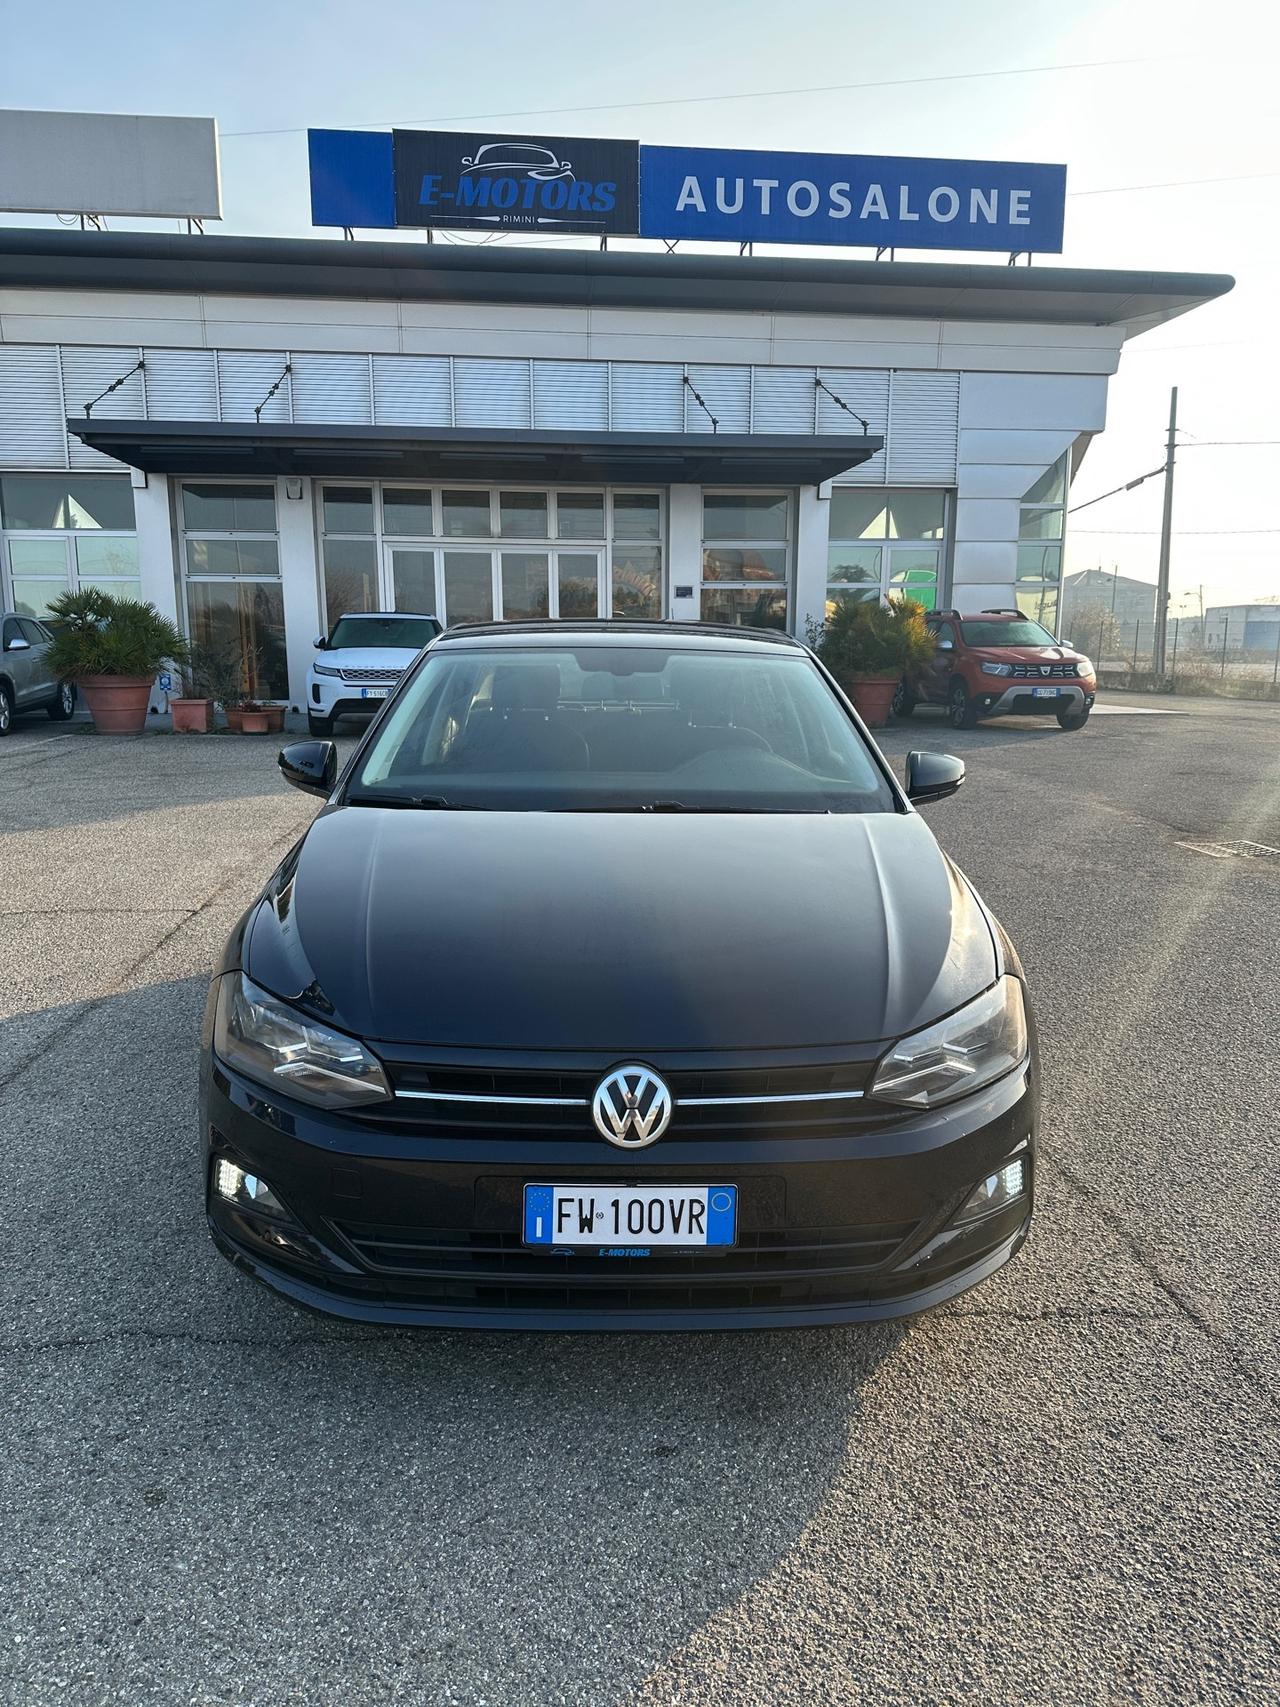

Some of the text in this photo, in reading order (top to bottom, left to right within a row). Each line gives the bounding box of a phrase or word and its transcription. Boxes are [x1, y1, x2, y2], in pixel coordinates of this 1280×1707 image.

[418, 174, 617, 213] E-MOTORS
[675, 175, 1032, 225] AUTOSALONE
[503, 214, 535, 223] RIMINI
[557, 1198, 705, 1235] FW 100VR
[599, 1248, 651, 1257] E-MOTORS
